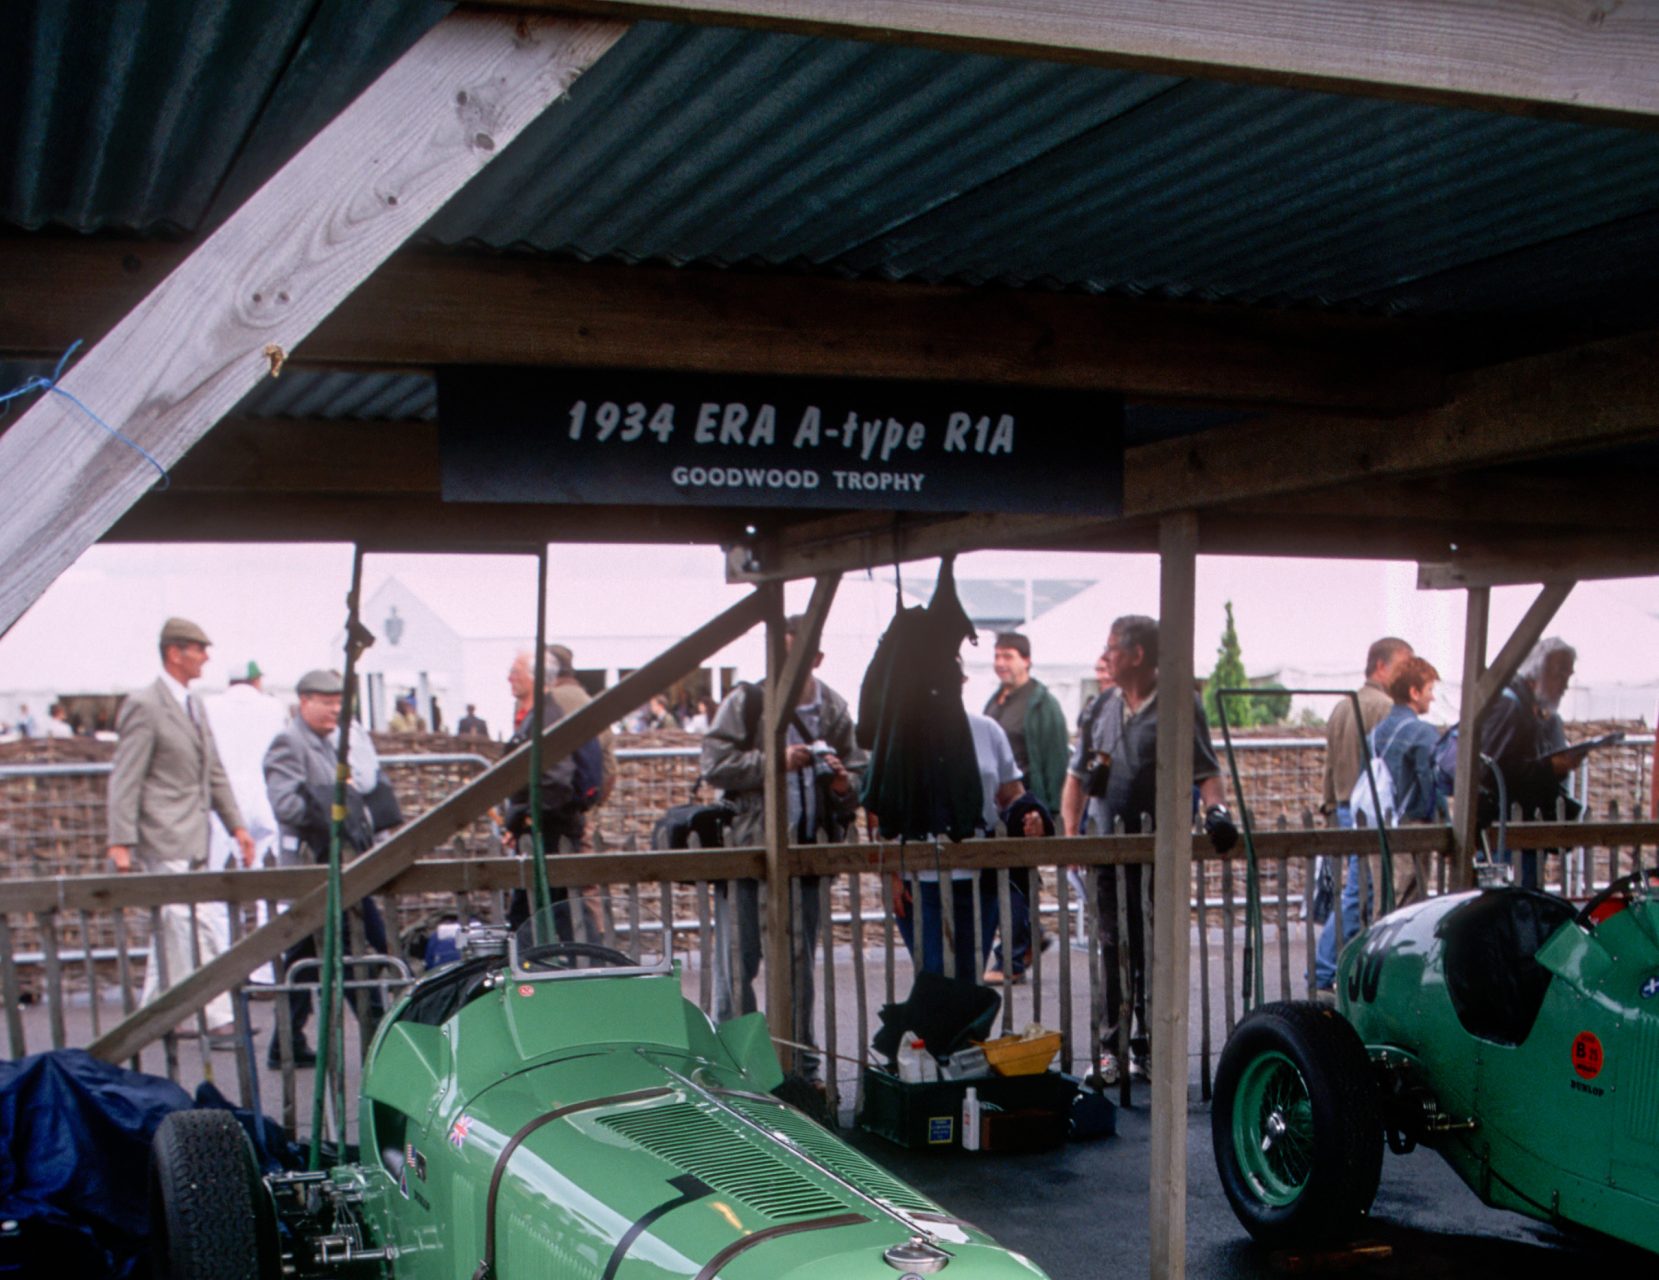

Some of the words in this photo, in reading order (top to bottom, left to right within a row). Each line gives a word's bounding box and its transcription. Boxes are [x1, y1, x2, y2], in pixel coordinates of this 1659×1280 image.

[568, 401, 675, 443] 1934
[694, 403, 775, 447] ERA
[793, 406, 925, 461] A-type
[943, 412, 1015, 455] R1A
[671, 466, 819, 488] GOODWOOD
[832, 470, 925, 491] TROPHY
